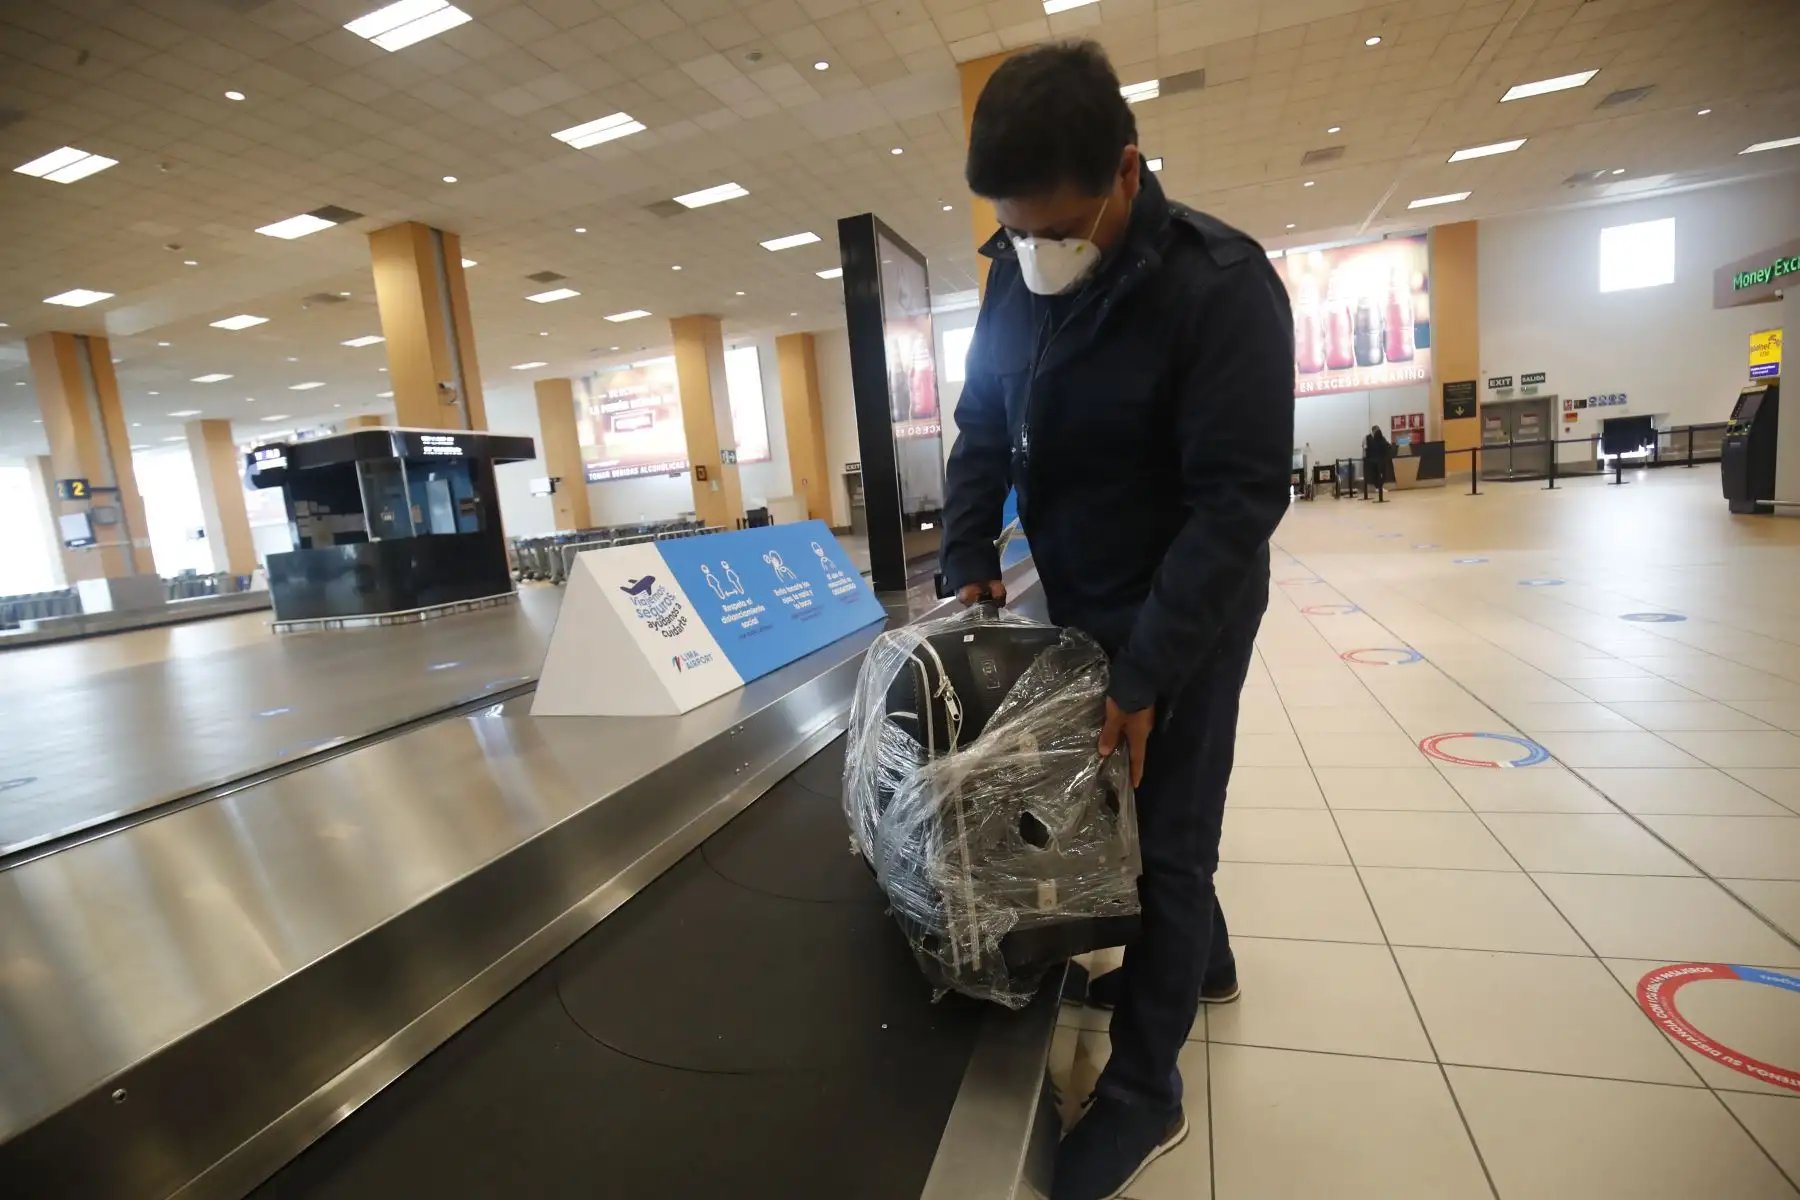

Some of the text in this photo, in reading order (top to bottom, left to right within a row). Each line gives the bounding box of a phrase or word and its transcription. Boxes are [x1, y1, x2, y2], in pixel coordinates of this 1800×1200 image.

[1733, 266, 1771, 291] Money
[1318, 377, 1360, 390] EXCESO
[1489, 378, 1512, 388] EXIT
[1522, 374, 1545, 384] SALIDA
[72, 481, 85, 496] 2
[630, 585, 666, 608] Viajemos
[636, 592, 676, 619] seguros
[662, 616, 687, 637] cuidarte
[681, 650, 699, 662] LIMA
[686, 653, 714, 670] AIRPORT
[1663, 1019, 1723, 1057] DISTANCIA
[1723, 1055, 1743, 1067] SU
